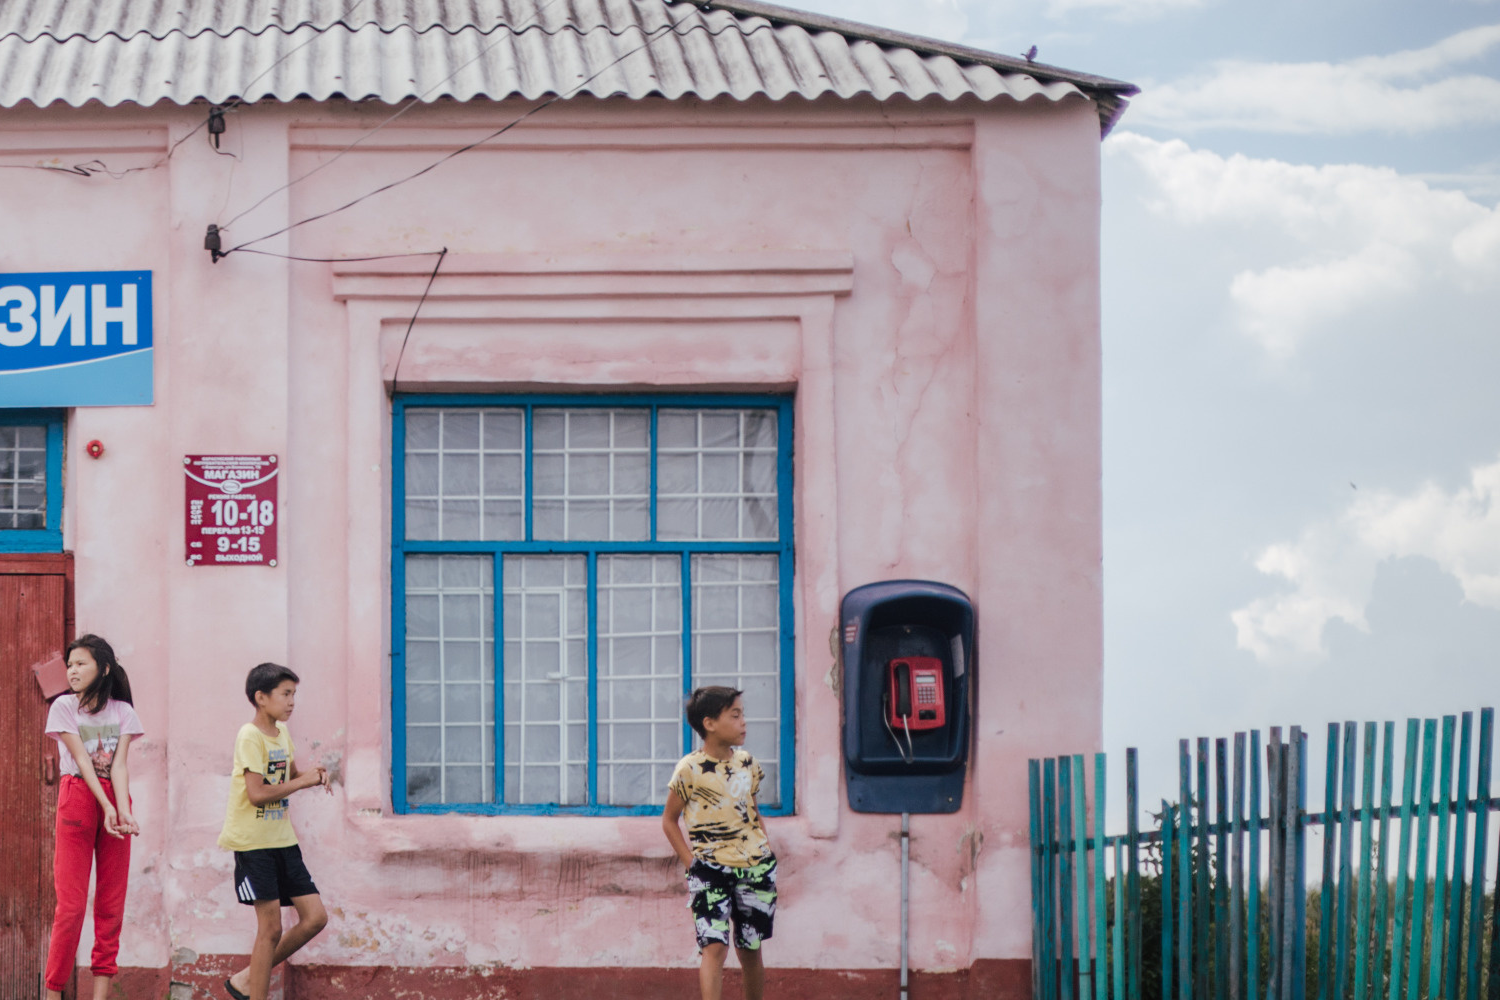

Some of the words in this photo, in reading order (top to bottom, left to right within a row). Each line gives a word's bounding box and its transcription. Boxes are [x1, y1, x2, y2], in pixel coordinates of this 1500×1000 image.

[204, 470, 259, 479] МАГАЗИН
[211, 499, 274, 526] 10-18
[201, 526, 240, 535] ПЕРЕРЫВ
[240, 525, 265, 535] 13-15
[216, 536, 261, 552] 9-15
[215, 553, 263, 562] ВЫХОДНОЙ
